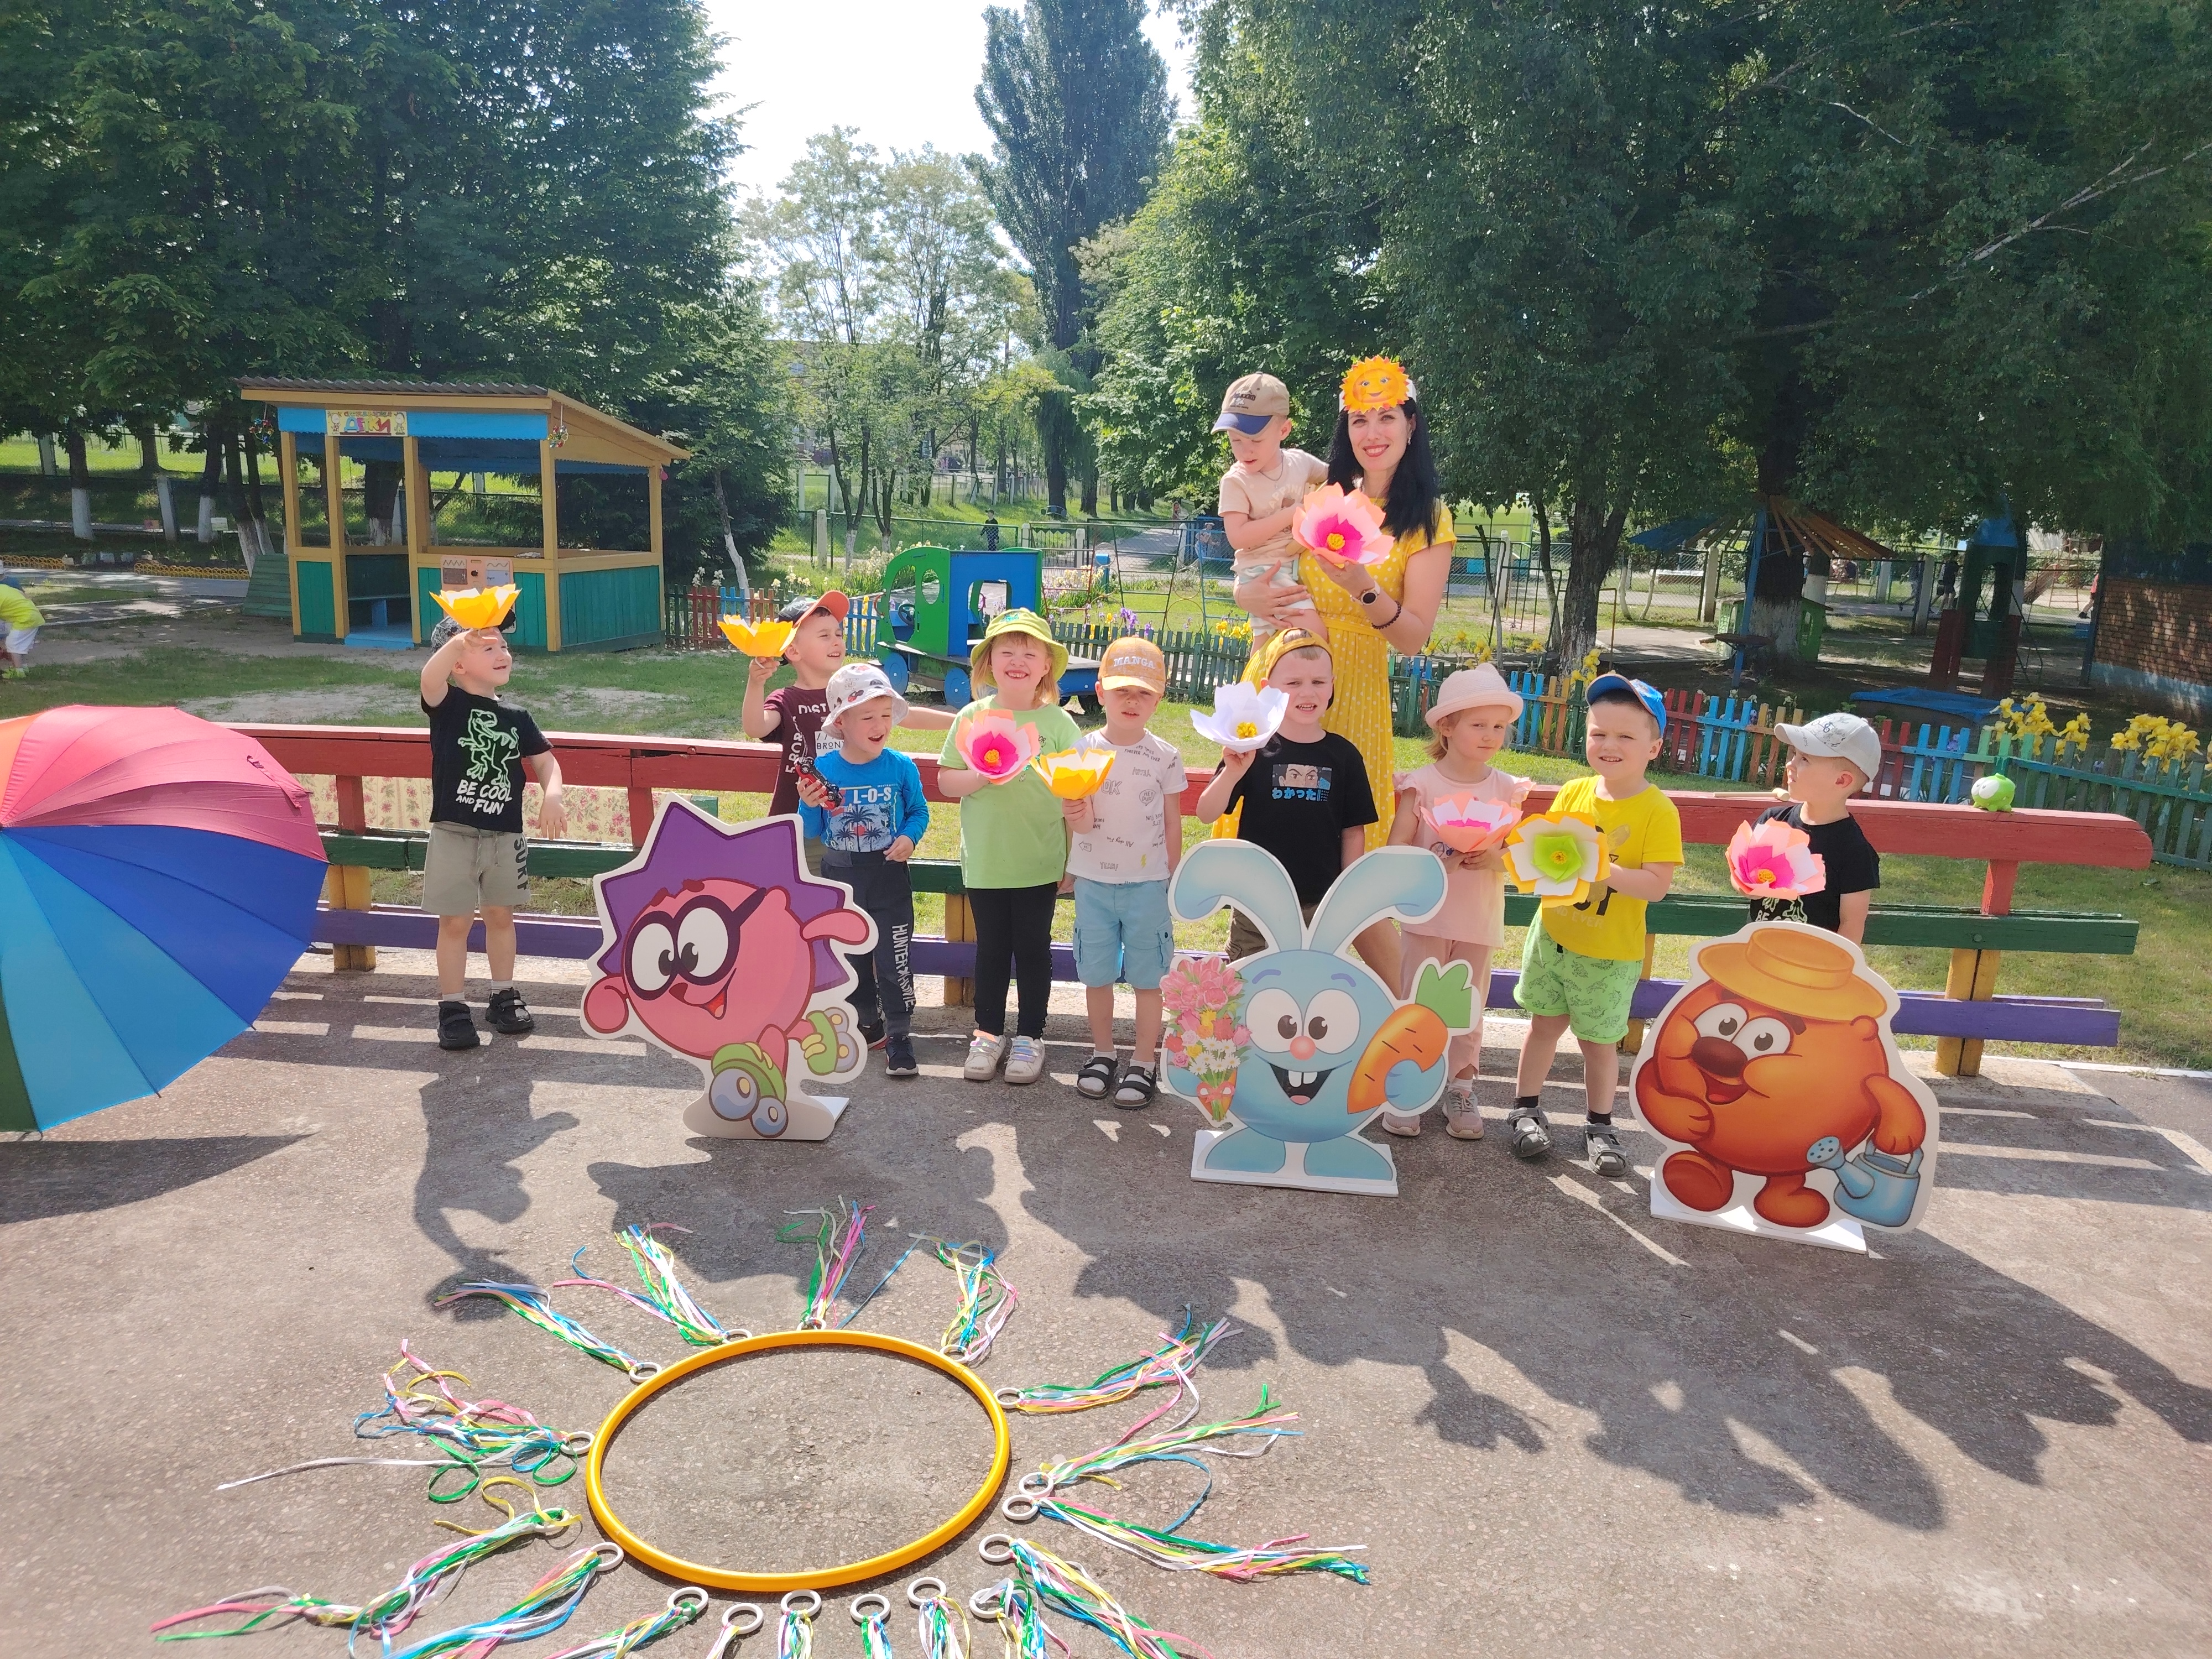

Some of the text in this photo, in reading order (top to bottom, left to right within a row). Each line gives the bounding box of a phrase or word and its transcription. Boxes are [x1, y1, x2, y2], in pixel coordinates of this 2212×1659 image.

[344, 417, 390, 433] ДЕТКИ
[1114, 656, 1155, 669] MANGA
[817, 741, 844, 749] BRON
[457, 779, 513, 801] BE COOL
[1101, 779, 1123, 795] OK
[1272, 787, 1316, 801] わかった
[456, 795, 504, 815] AND FUN
[1572, 911, 1604, 928] EVER
[1755, 910, 1770, 922] BE
